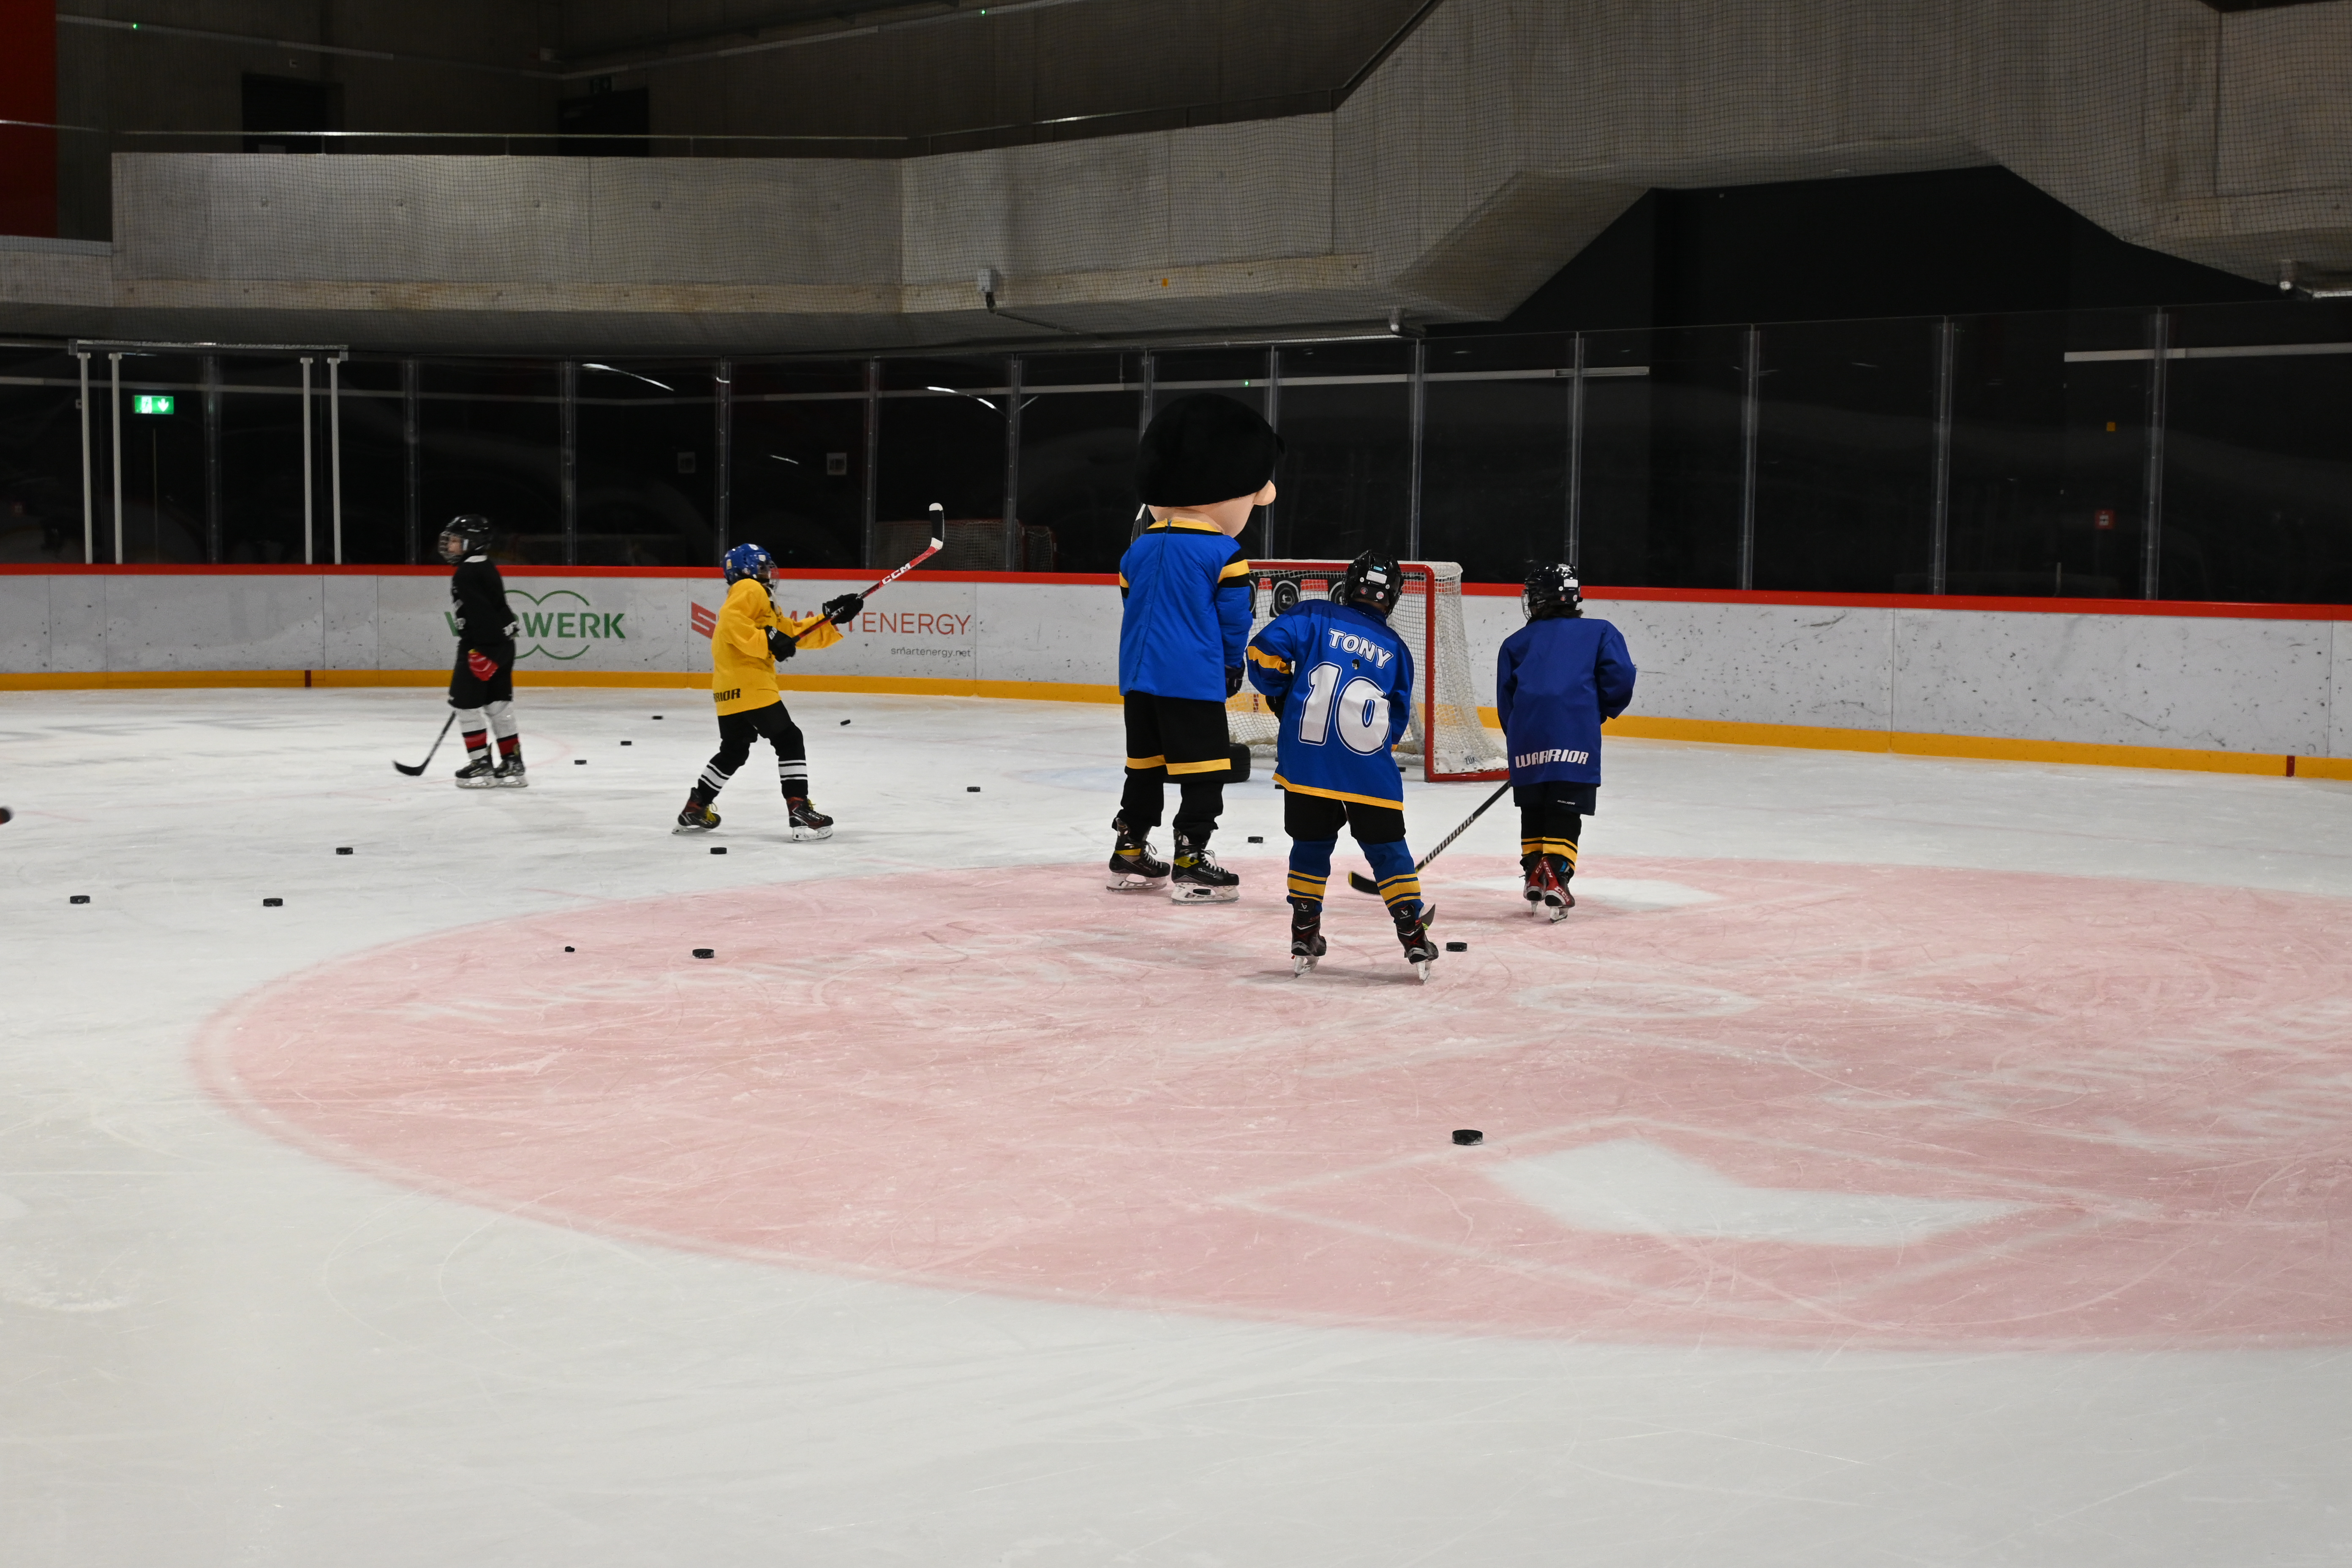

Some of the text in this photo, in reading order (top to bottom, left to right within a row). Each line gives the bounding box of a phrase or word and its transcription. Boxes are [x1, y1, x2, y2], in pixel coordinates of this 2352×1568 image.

[882, 563, 911, 585] CCM
[891, 647, 971, 658] smartenergy.net
[1328, 629, 1393, 668] TONY
[1298, 662, 1391, 756] 10
[1515, 749, 1589, 768] WARRIOR
